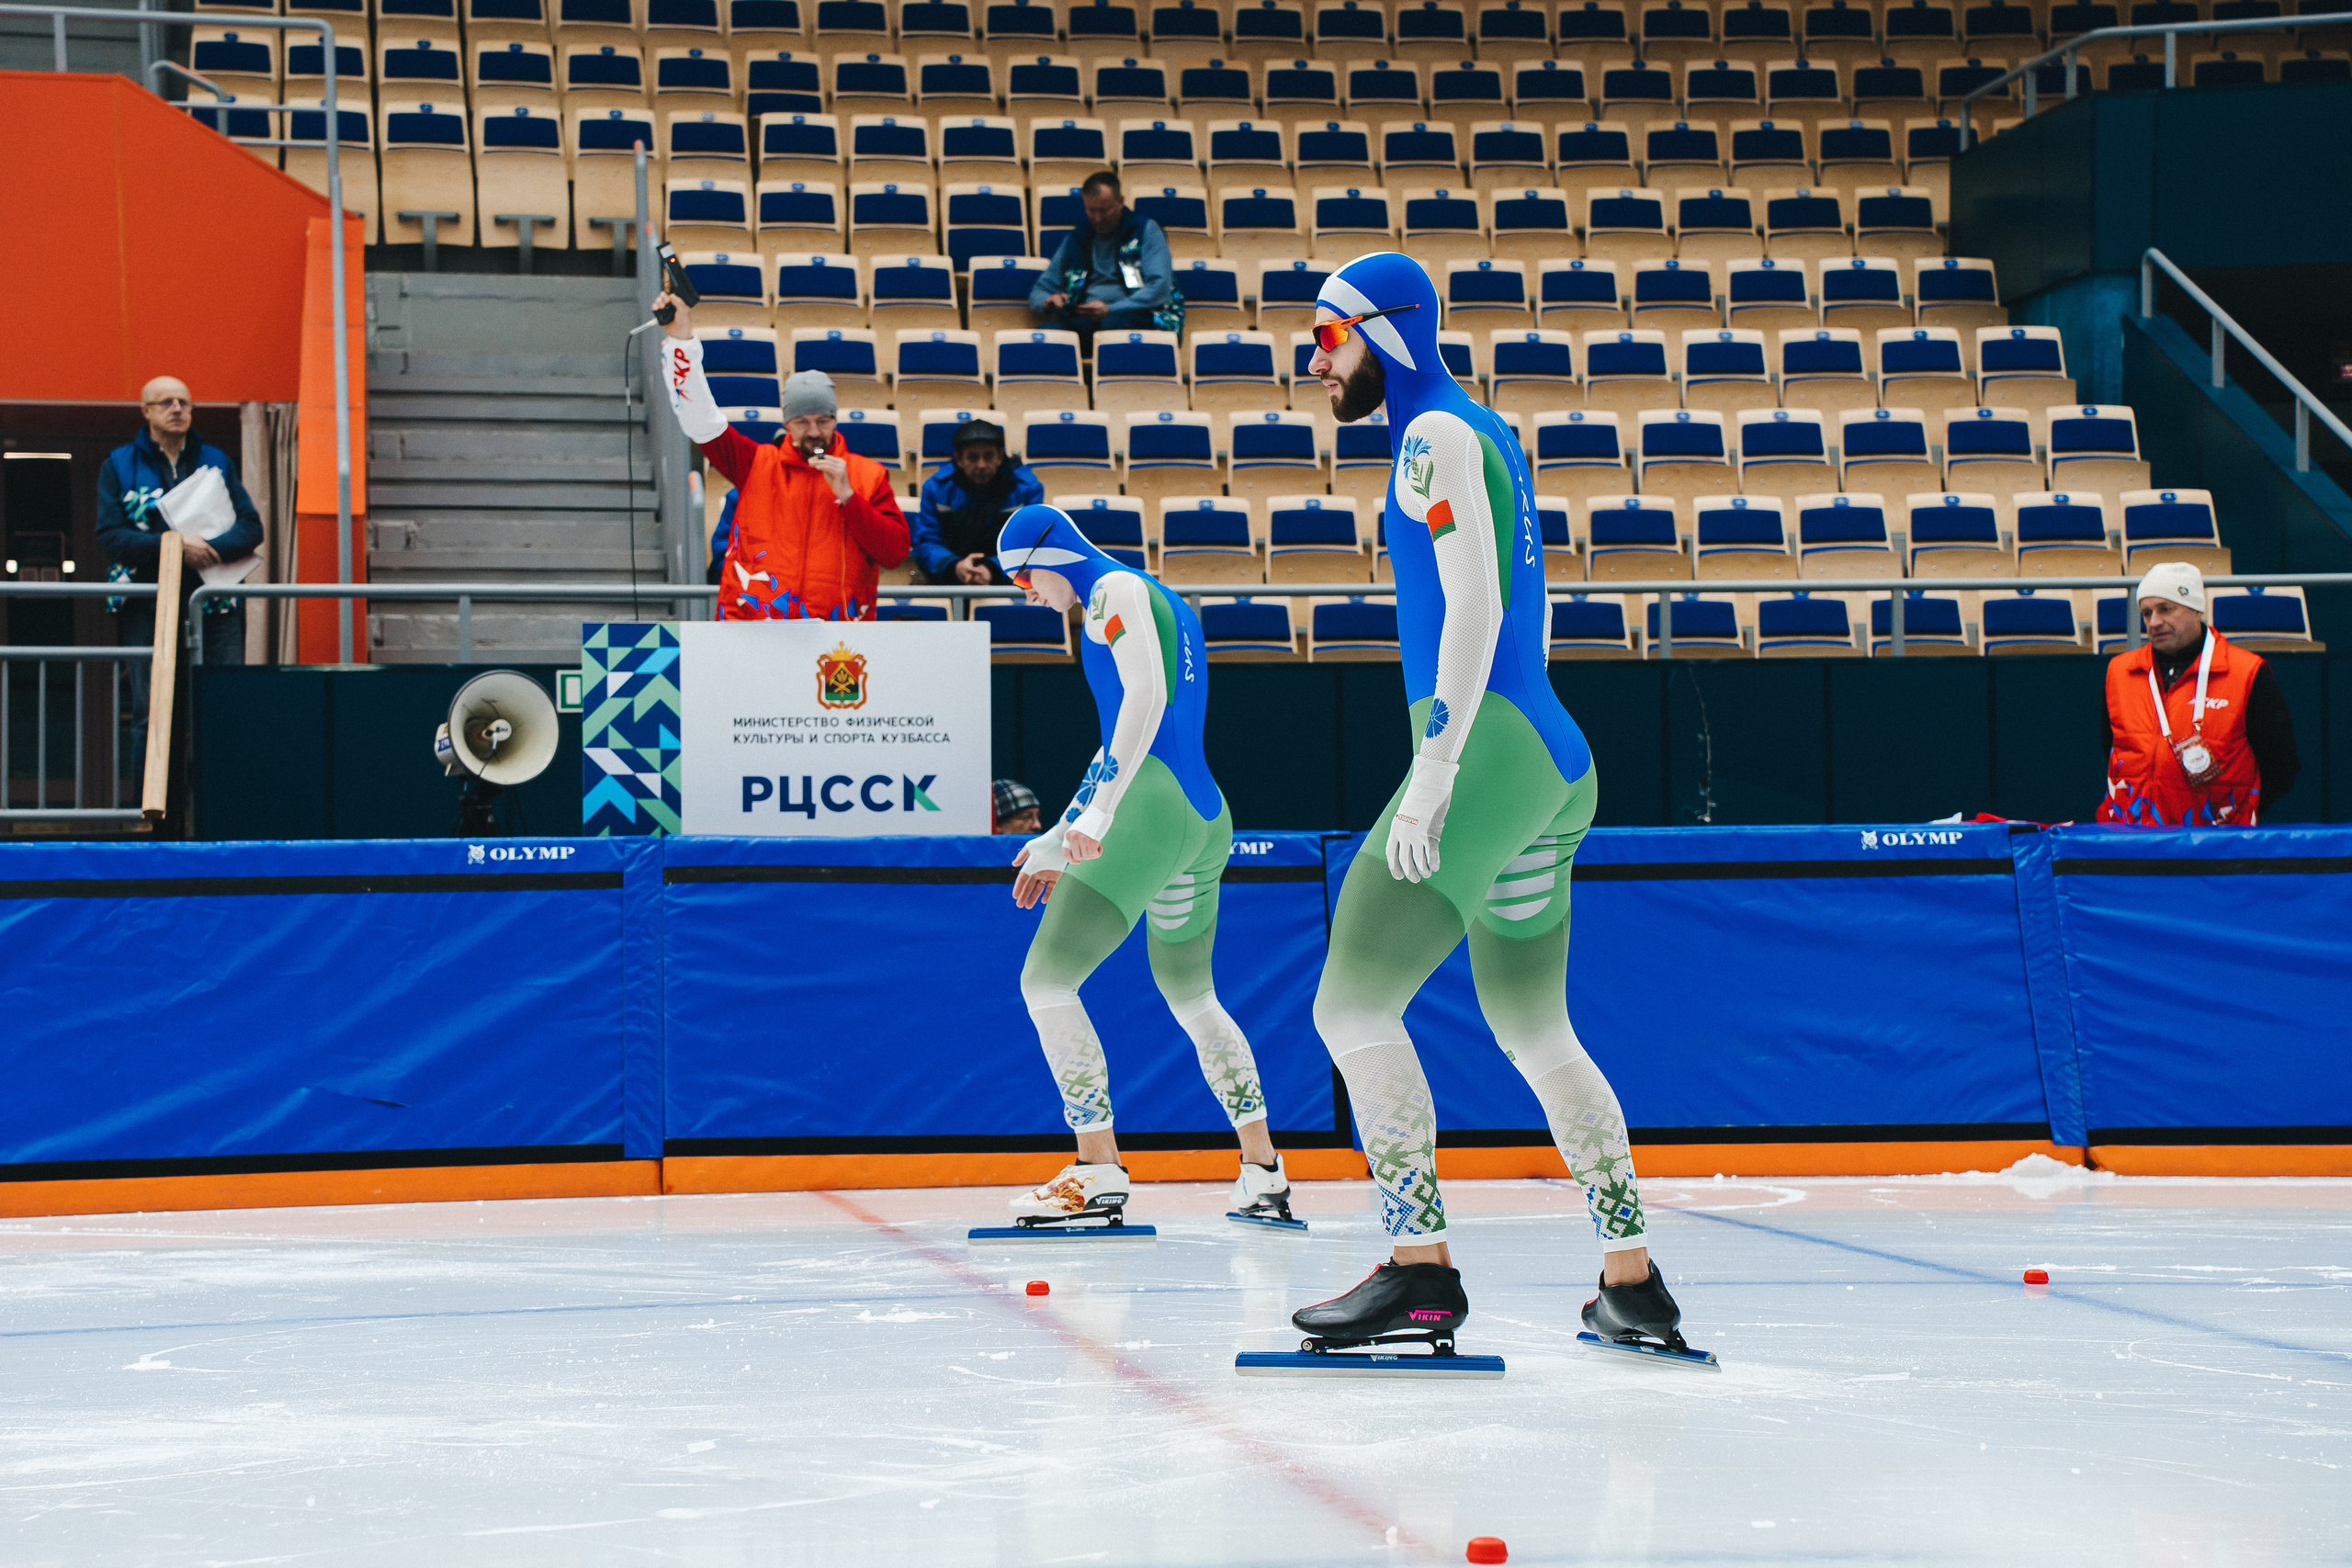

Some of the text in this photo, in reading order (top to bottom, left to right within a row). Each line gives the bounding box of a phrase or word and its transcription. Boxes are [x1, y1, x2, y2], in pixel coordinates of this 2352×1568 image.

[733, 714, 934, 728] МИНИСТЕРСТВО ФИЗИЧЕСКОЙ
[733, 733, 951, 744] КУЛЬТУРЫ И СПОРТА КУЗБАССА
[742, 773, 942, 819] РЦССК
[1882, 831, 1963, 846] OLYMP
[490, 846, 576, 861] OLYMP
[1229, 841, 1274, 854] YMP
[1095, 1195, 1125, 1205] VIKING
[1369, 1354, 1398, 1362] VIKING
